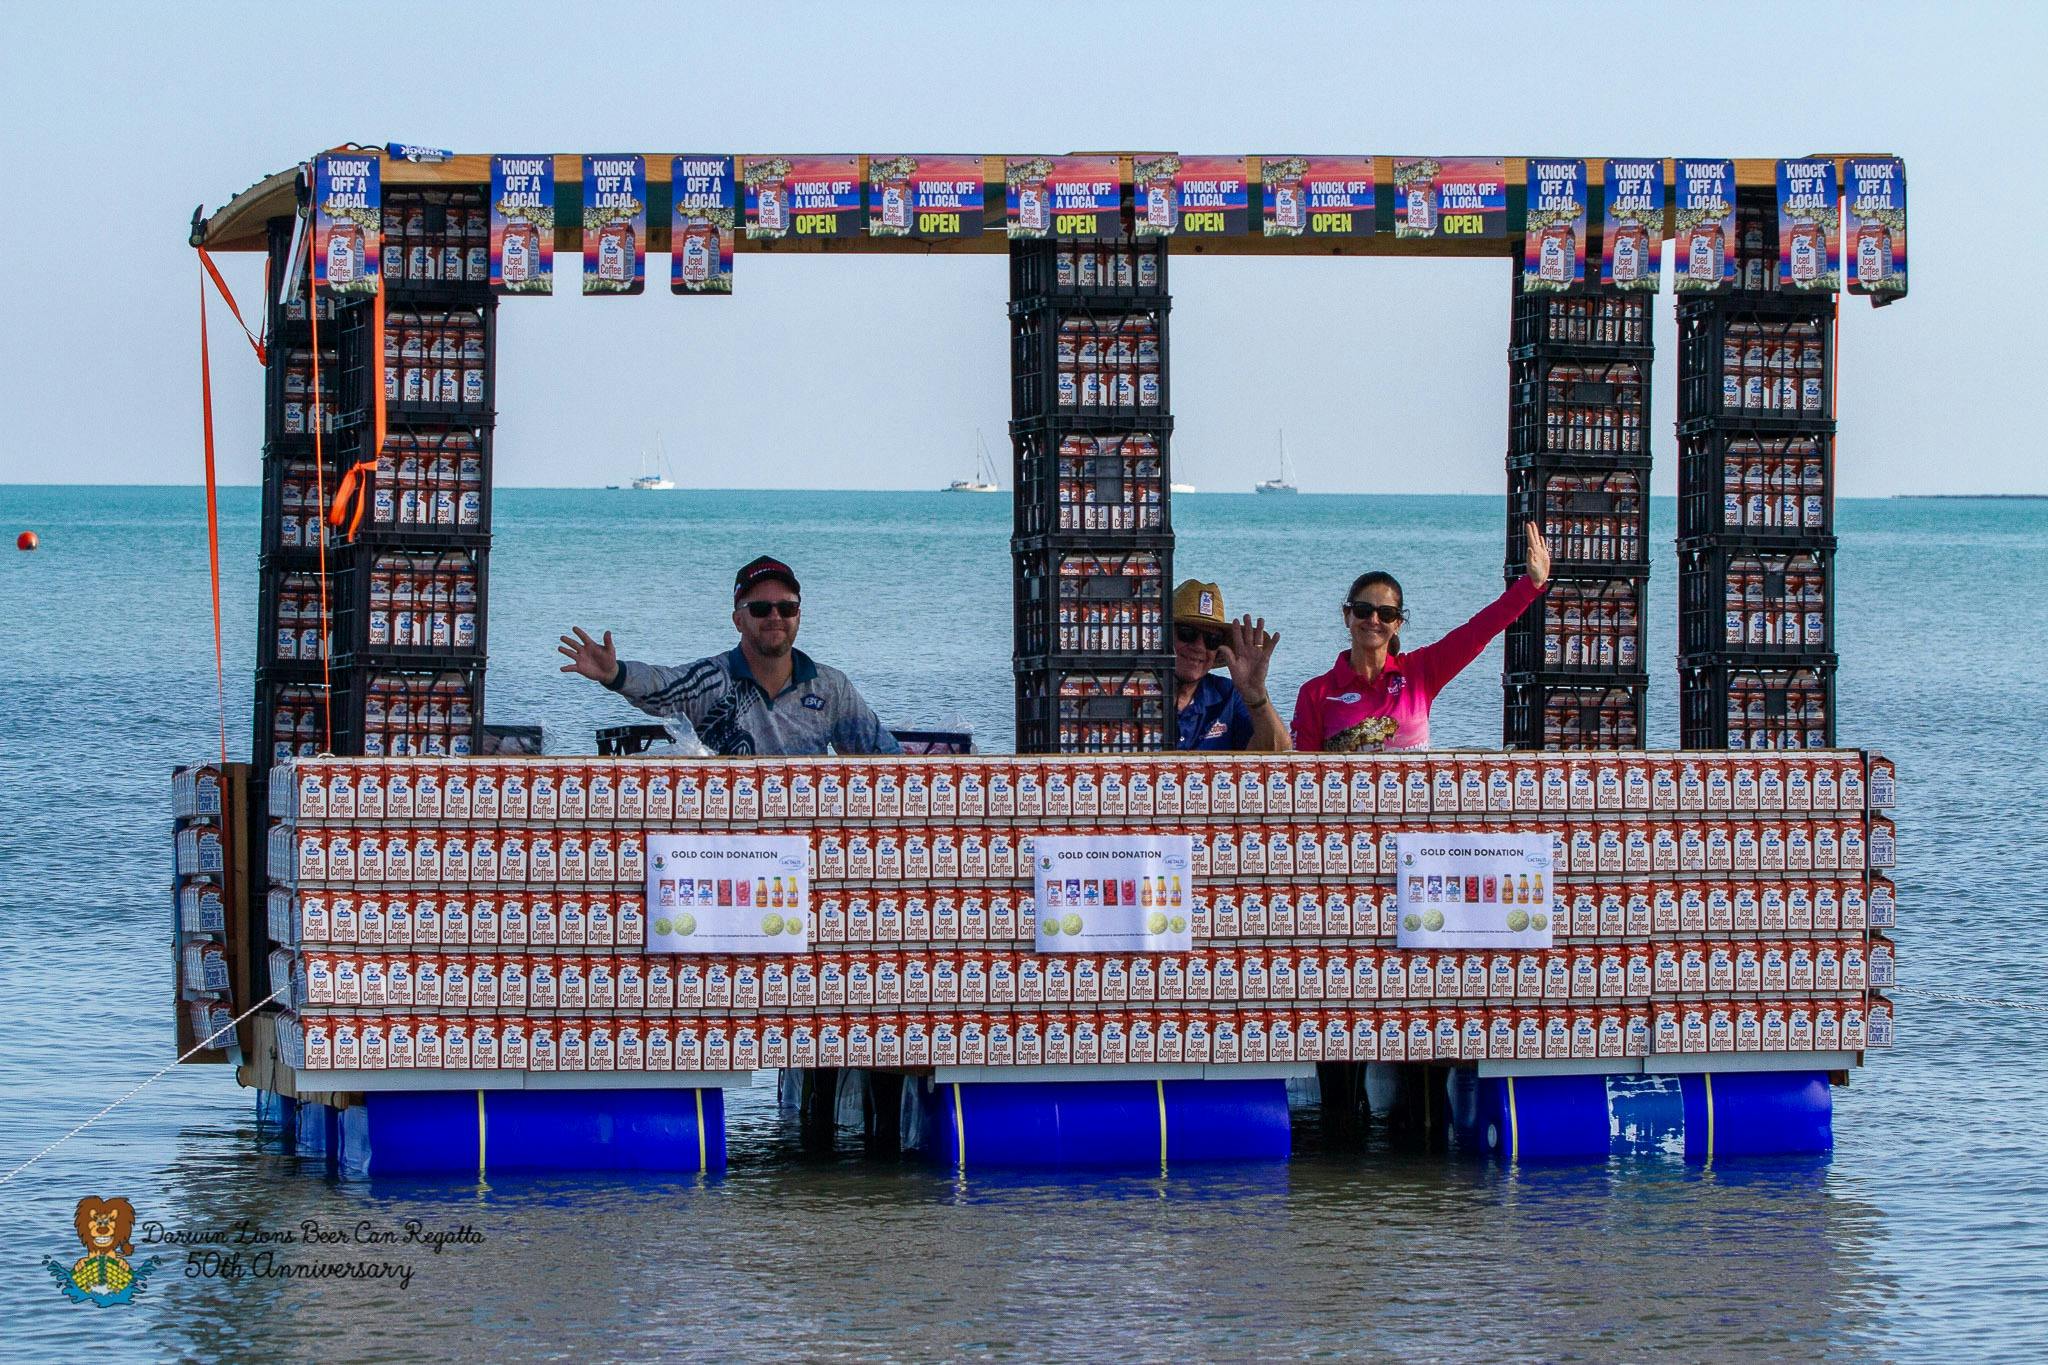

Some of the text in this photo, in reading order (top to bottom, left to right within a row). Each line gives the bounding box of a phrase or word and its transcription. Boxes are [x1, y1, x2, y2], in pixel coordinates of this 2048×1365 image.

[328, 160, 370, 177] KNOCK
[502, 160, 544, 177] KNOCK
[594, 160, 635, 177] KNOCK
[683, 161, 725, 177] KNOCK
[1537, 165, 1576, 179] KNOCK
[1615, 164, 1654, 179] KNOCK
[1686, 164, 1725, 179] KNOCK
[1786, 164, 1826, 178] KNOCK
[1854, 164, 1894, 179] KNOCK
[332, 176, 367, 192] OFF A
[506, 176, 541, 192] OFF A
[598, 176, 632, 192] OFF A
[687, 177, 721, 193] OFF A
[794, 181, 851, 196] KNOCK OFF
[919, 181, 975, 195] KNOCK OFF
[1055, 182, 1111, 196] KNOCK OFF
[1183, 180, 1239, 194] KNOCK OFF
[1311, 181, 1365, 194] KNOCK OFF
[1442, 182, 1497, 196] KNOCK OFF
[1541, 180, 1574, 195] OFF A
[1618, 180, 1651, 195] OFF A
[1689, 180, 1722, 195] OFF A
[1791, 179, 1825, 193] OFF A
[1858, 180, 1891, 195] OFF A
[330, 193, 368, 209] LOCAL
[504, 192, 541, 209] LOCAL
[595, 192, 633, 209] LOCAL
[685, 193, 723, 209] LOCAL
[795, 194, 838, 209] A LOCAL
[919, 194, 962, 208] A LOCAL
[1055, 195, 1099, 209] A LOCAL
[1184, 194, 1226, 207] A LOCAL
[1312, 194, 1353, 207] A LOCAL
[1443, 196, 1484, 209] A LOCAL
[1538, 195, 1575, 211] LOCAL
[1616, 195, 1653, 211] LOCAL
[1687, 195, 1724, 210] LOCAL
[1789, 193, 1827, 209] LOCAL
[1856, 195, 1893, 210] LOCAL
[764, 207, 775, 216] Iced
[888, 205, 898, 214] Iced
[1025, 207, 1036, 216] Iced
[1151, 204, 1163, 213] Iced
[1280, 205, 1291, 214] Iced
[1412, 206, 1423, 215] Iced
[759, 216, 779, 227] Coffee
[796, 213, 837, 235] OPEN
[883, 213, 903, 224] Coffee
[920, 213, 960, 233] OPEN
[1021, 216, 1040, 227] Coffee
[1057, 213, 1097, 234] OPEN
[1149, 212, 1168, 224] Coffee
[1184, 212, 1225, 232] OPEN
[1276, 213, 1295, 224] Coffee
[1312, 213, 1352, 233] OPEN
[1408, 215, 1426, 226] Coffee
[1443, 215, 1483, 234] OPEN
[332, 257, 347, 266] Iced
[507, 256, 522, 266] Iced
[602, 255, 618, 265] Iced
[688, 257, 703, 266] Iced
[1545, 257, 1558, 266] Iced
[1618, 257, 1632, 266] Iced
[1695, 256, 1708, 264] Iced
[1796, 257, 1810, 266] Iced
[1862, 257, 1875, 266] Iced
[329, 266, 351, 281] Coffee
[504, 265, 526, 280] Coffee
[599, 265, 621, 279] Coffee
[684, 266, 706, 280] Coffee
[1542, 265, 1561, 278] Coffee
[1615, 266, 1635, 278] Coffee
[1691, 264, 1711, 277] Coffee
[1793, 266, 1814, 277] Coffee
[1859, 266, 1879, 278] Coffee
[1846, 788, 1858, 796] Iced
[1872, 785, 1885, 794] Drink
[306, 795, 320, 803] Iced
[363, 795, 378, 803] Iced
[1842, 796, 1862, 808] Coffee
[1872, 794, 1886, 803] LOVE
[302, 804, 324, 817] Coffee
[360, 804, 381, 817] Coffee
[671, 850, 778, 859] GOLD COIN DONATION
[1057, 850, 1162, 859] GOLD COIN DONATION
[1846, 847, 1859, 856] Iced
[1872, 844, 1885, 854] Drink
[306, 856, 319, 865] Iced
[1842, 856, 1863, 867] Coffee
[1872, 854, 1886, 862] LOVE
[302, 866, 323, 879] Coffee
[1303, 912, 1316, 920] Iced
[1872, 905, 1885, 914] Drink
[1872, 914, 1886, 923] LOVE
[1300, 921, 1320, 935] Coffee
[966, 1042, 979, 1050] Iced
[1022, 1042, 1035, 1050] Iced
[962, 1051, 982, 1064] Coffee
[1018, 1052, 1039, 1064] Coffee
